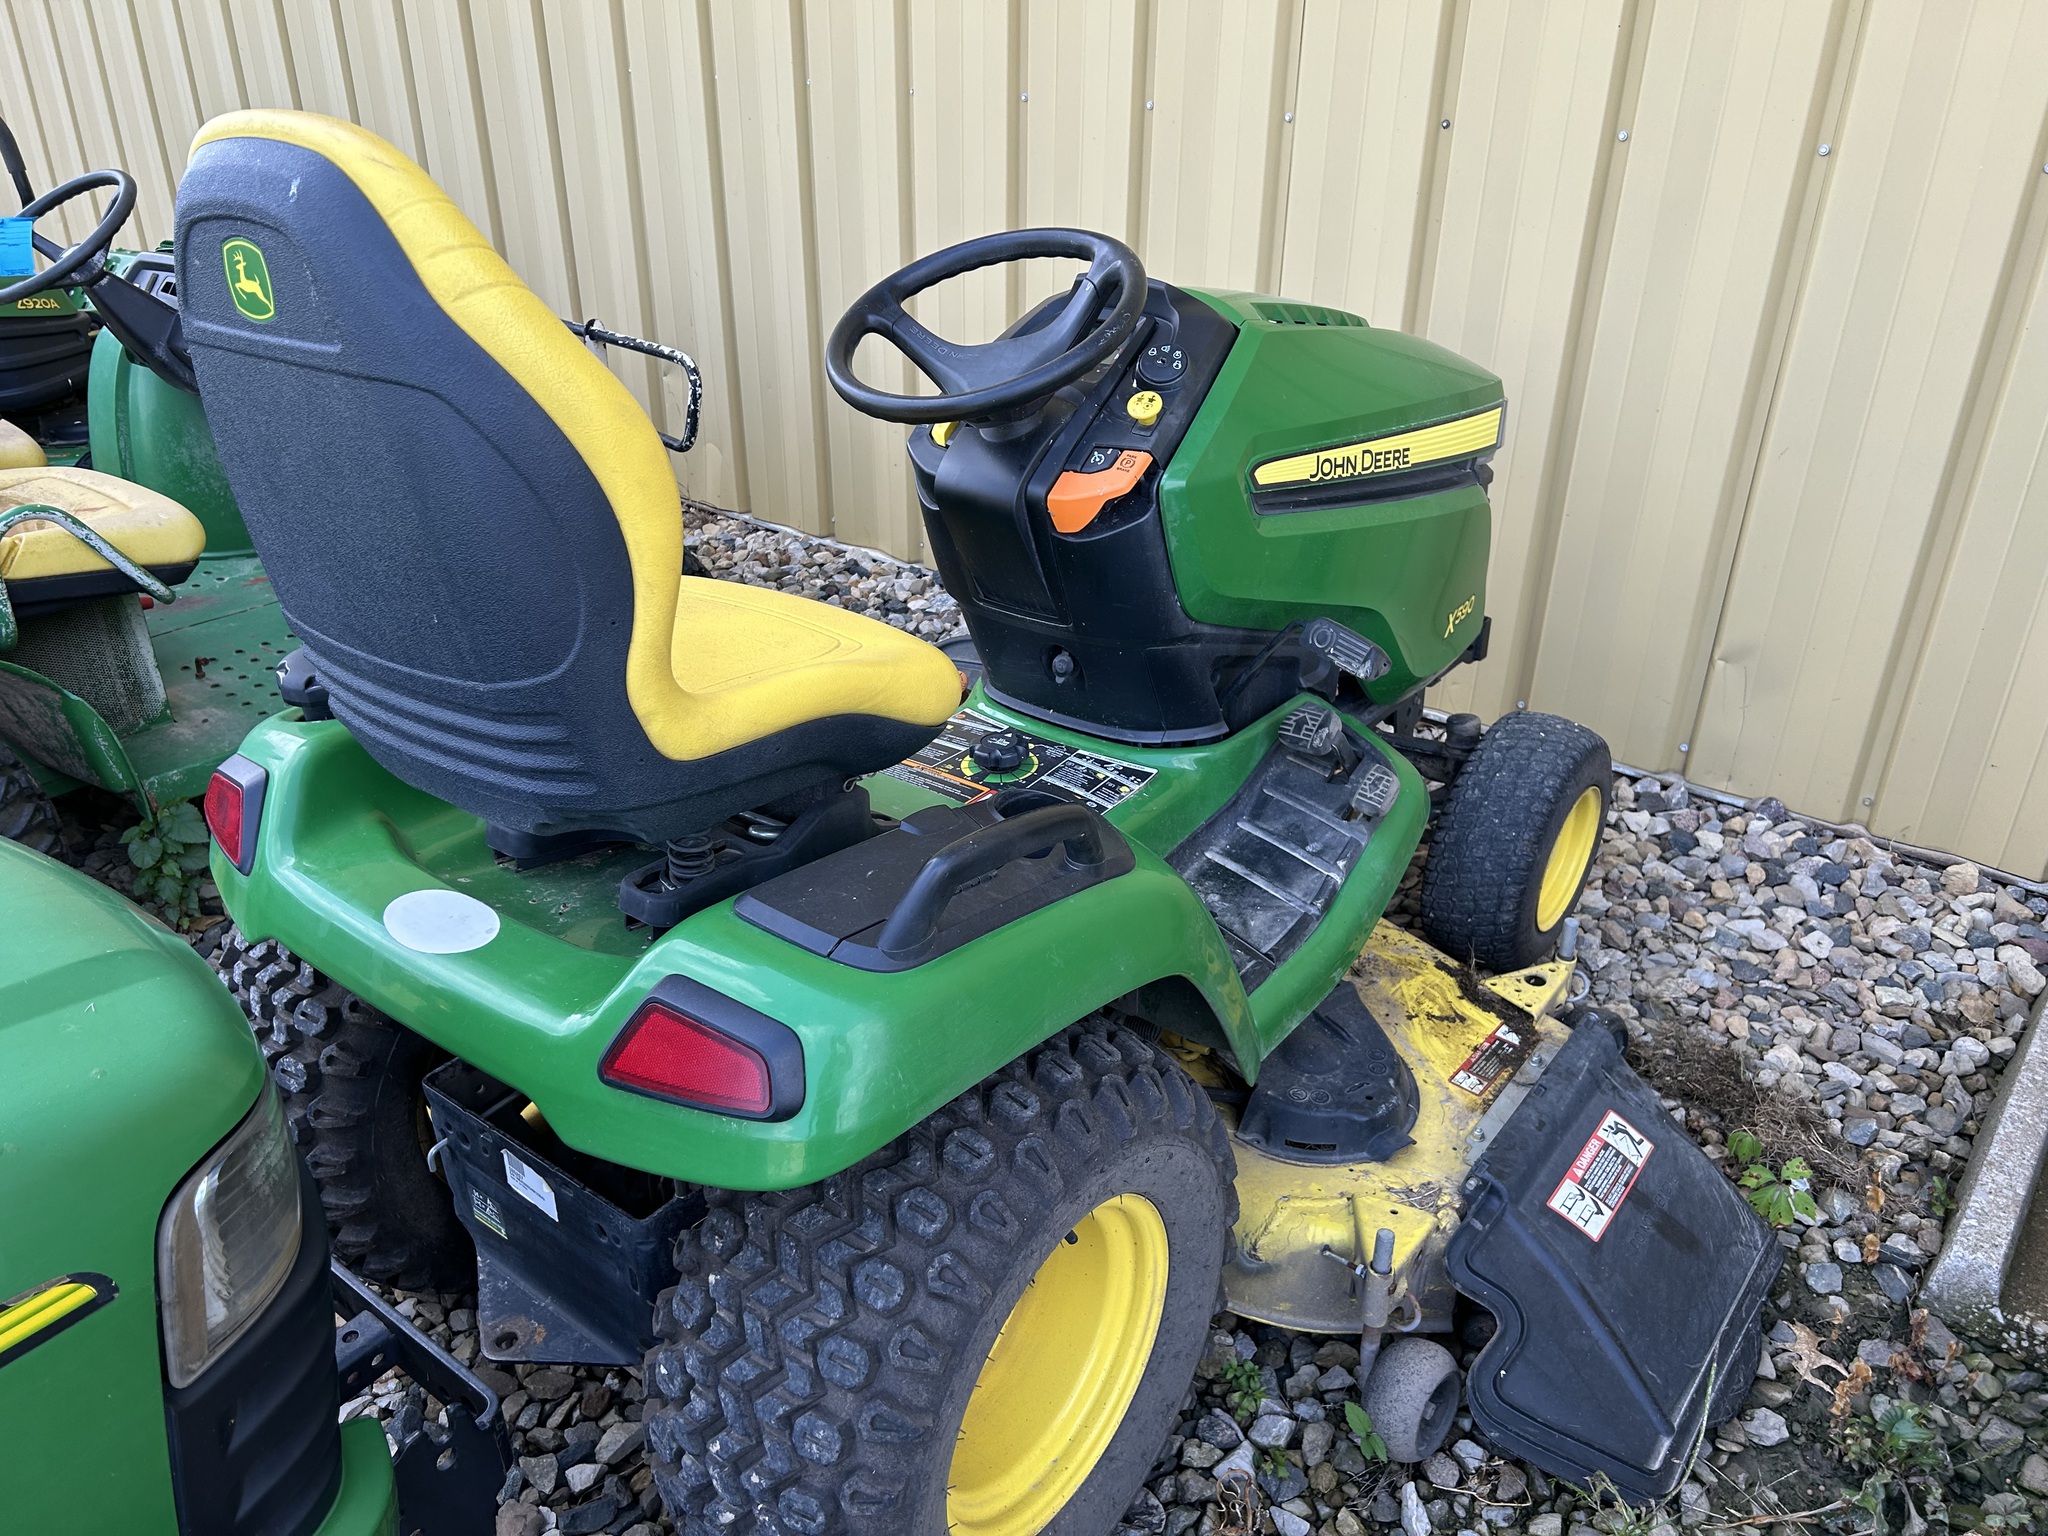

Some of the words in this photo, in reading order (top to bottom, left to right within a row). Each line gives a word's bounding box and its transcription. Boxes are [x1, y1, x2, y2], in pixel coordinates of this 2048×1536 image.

[1309, 455, 1357, 479] JOHN
[1361, 447, 1411, 471] DEERE
[1444, 594, 1476, 639] X590
[1577, 1138, 1602, 1168] DANGER
